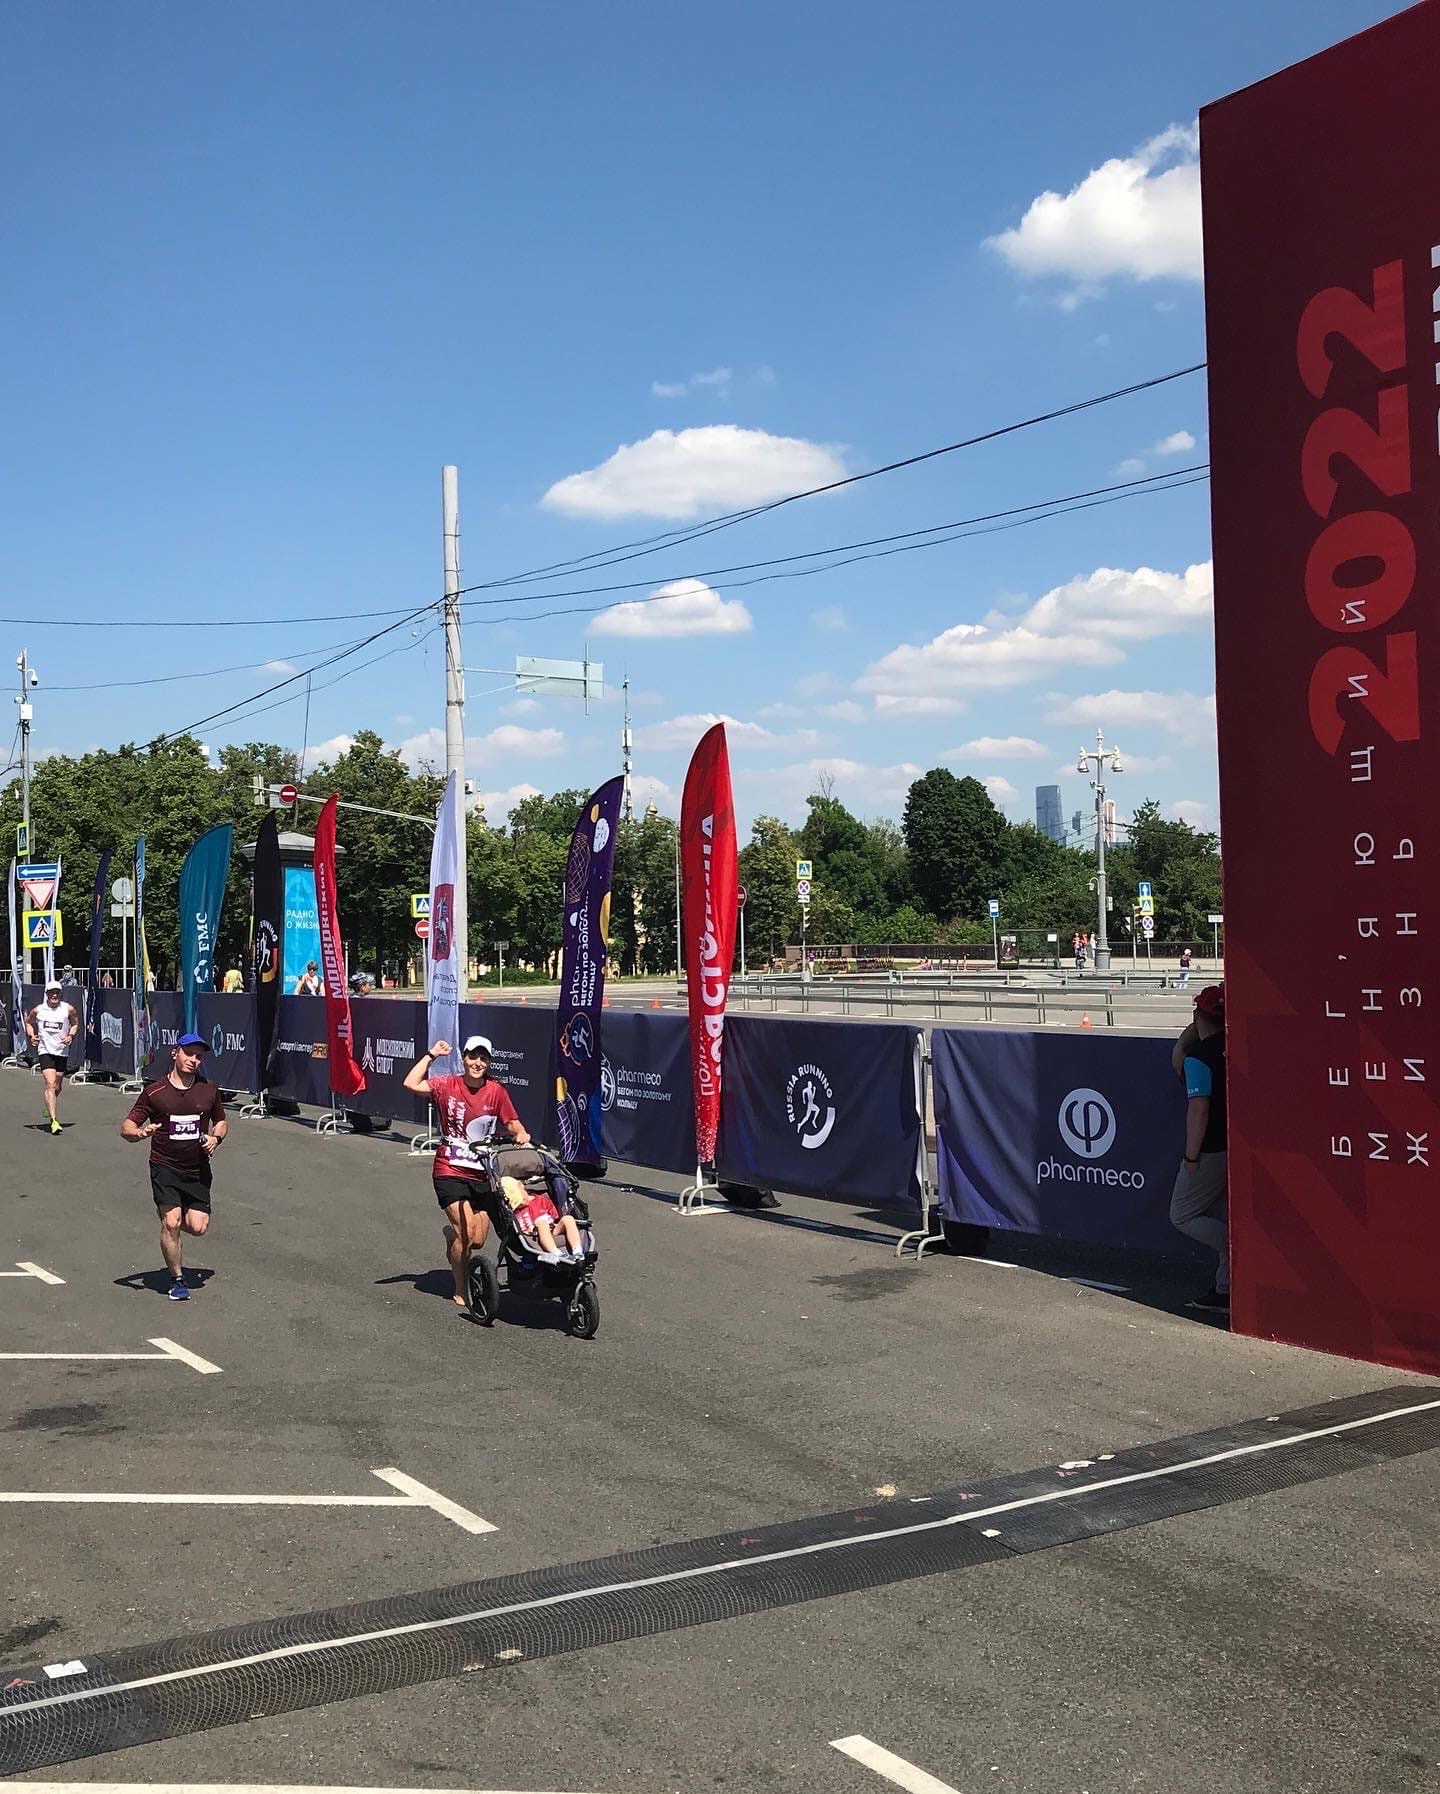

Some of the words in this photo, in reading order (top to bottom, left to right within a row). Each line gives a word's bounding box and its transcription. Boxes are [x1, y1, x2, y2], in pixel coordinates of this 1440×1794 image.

[1297, 258, 1420, 757] 2022
[1340, 599, 1390, 1167] МЕНЯЮЩИЙ
[286, 910, 315, 919] РАДИО
[195, 911, 210, 953] FMC
[286, 921, 293, 929] О
[582, 951, 589, 968] ПО
[1393, 837, 1430, 1167] ЖИЗНЬ
[225, 1033, 246, 1052] FMC
[376, 1056, 394, 1075] СПОРТ
[490, 1062, 509, 1072] спорта
[509, 1075, 529, 1086] Москвы
[617, 1065, 662, 1086] pharmeco
[634, 1088, 642, 1098] ПО
[642, 1090, 672, 1102] ЗОЛОТОМУ
[786, 1074, 799, 1123] RUSSIA
[797, 1063, 833, 1099] RUNNING
[616, 1098, 638, 1110] КОЛЬЦУ
[175, 1123, 196, 1132] 5715
[1036, 1154, 1145, 1190] pharmeco
